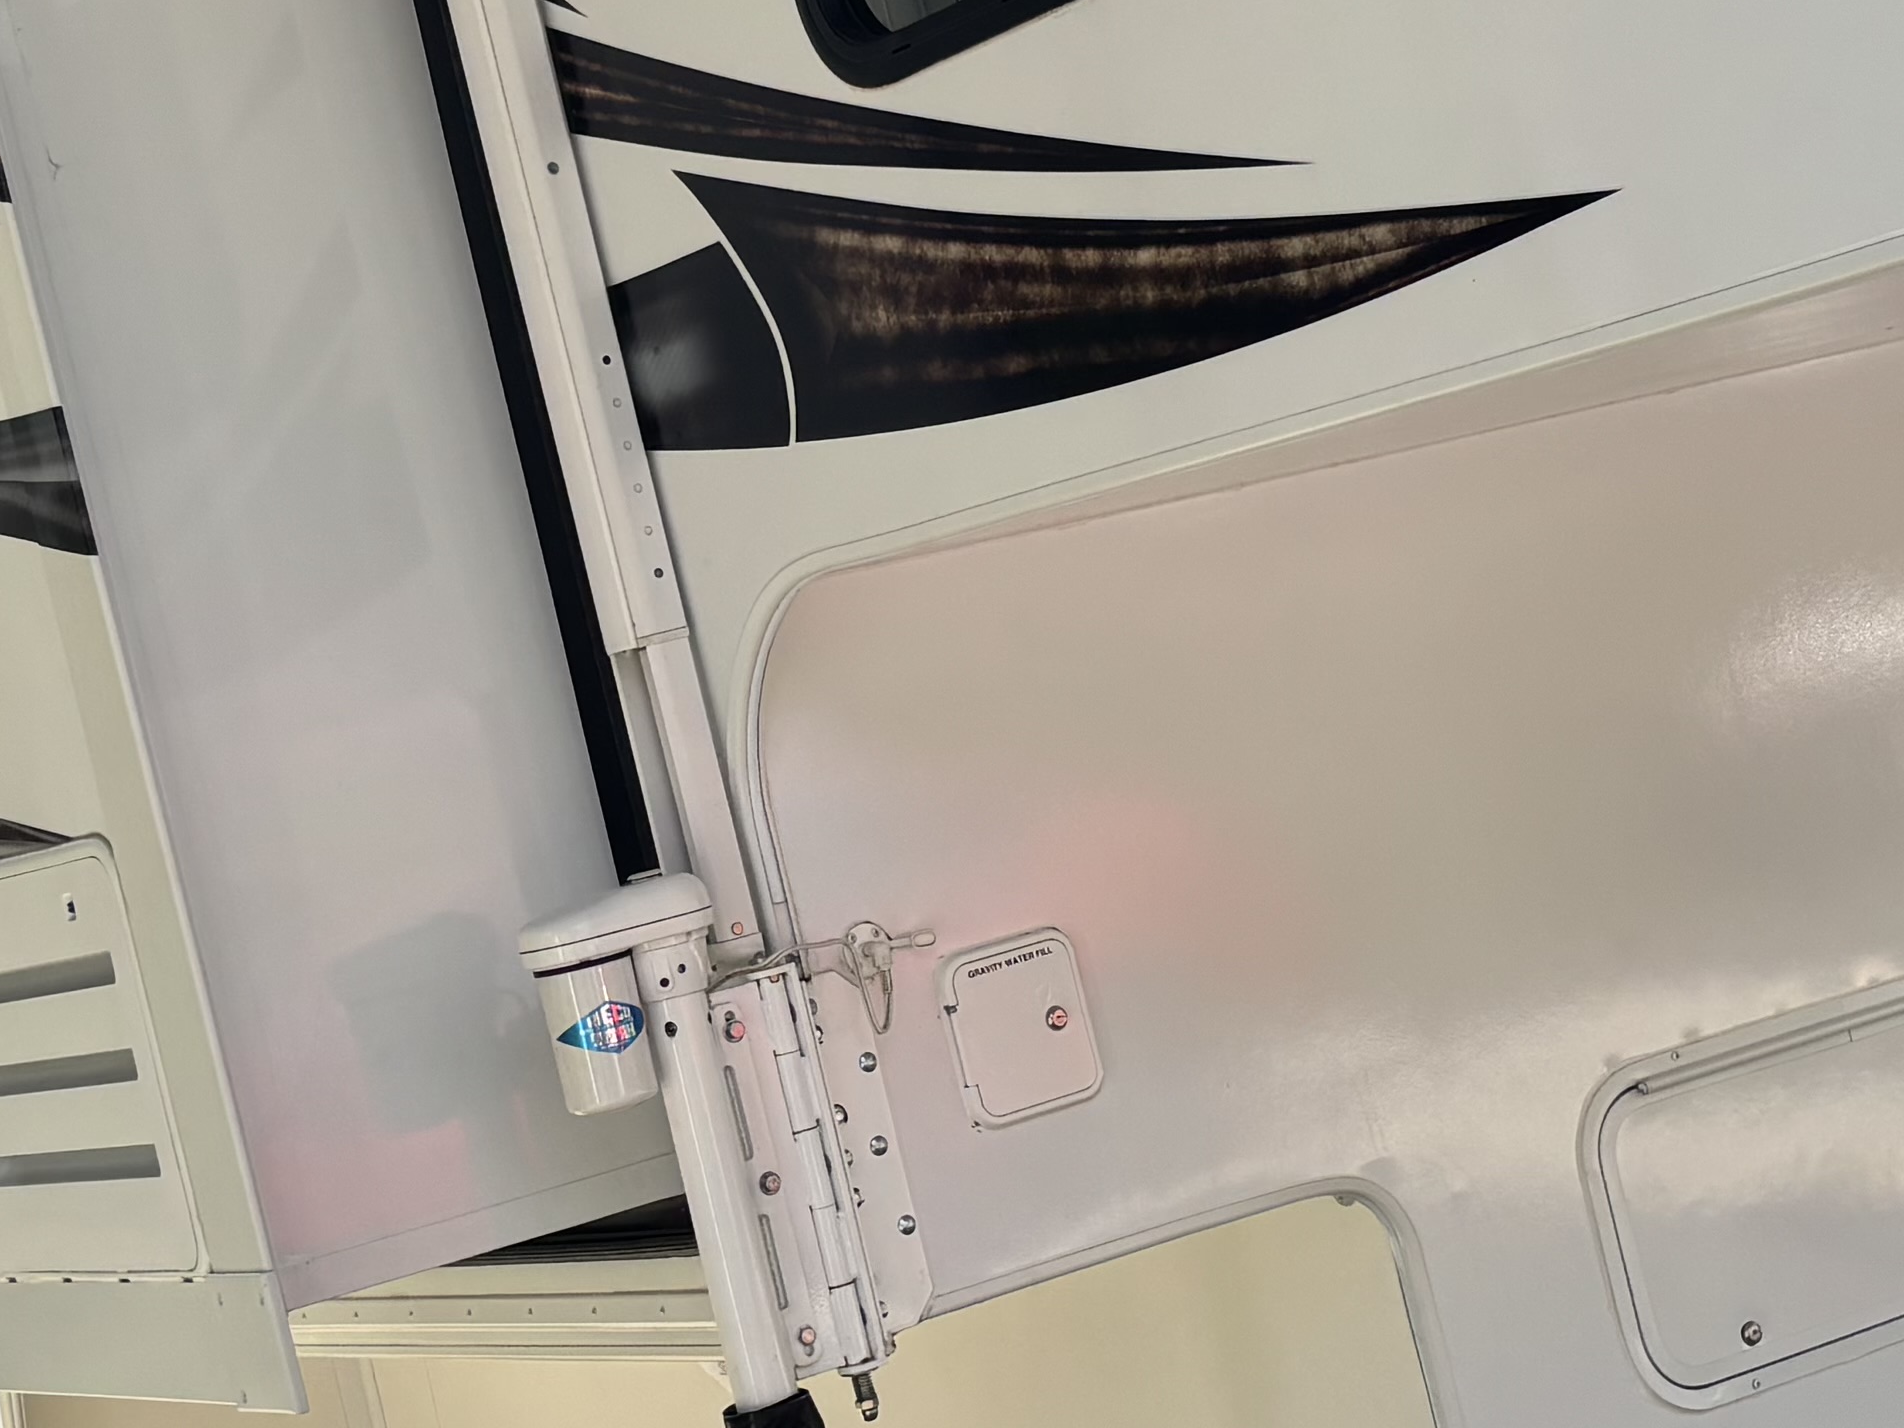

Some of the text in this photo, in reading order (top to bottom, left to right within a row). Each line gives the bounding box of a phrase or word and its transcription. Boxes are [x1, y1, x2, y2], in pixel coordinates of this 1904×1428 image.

[967, 946, 1053, 979] GRAVITY WATER FILL
